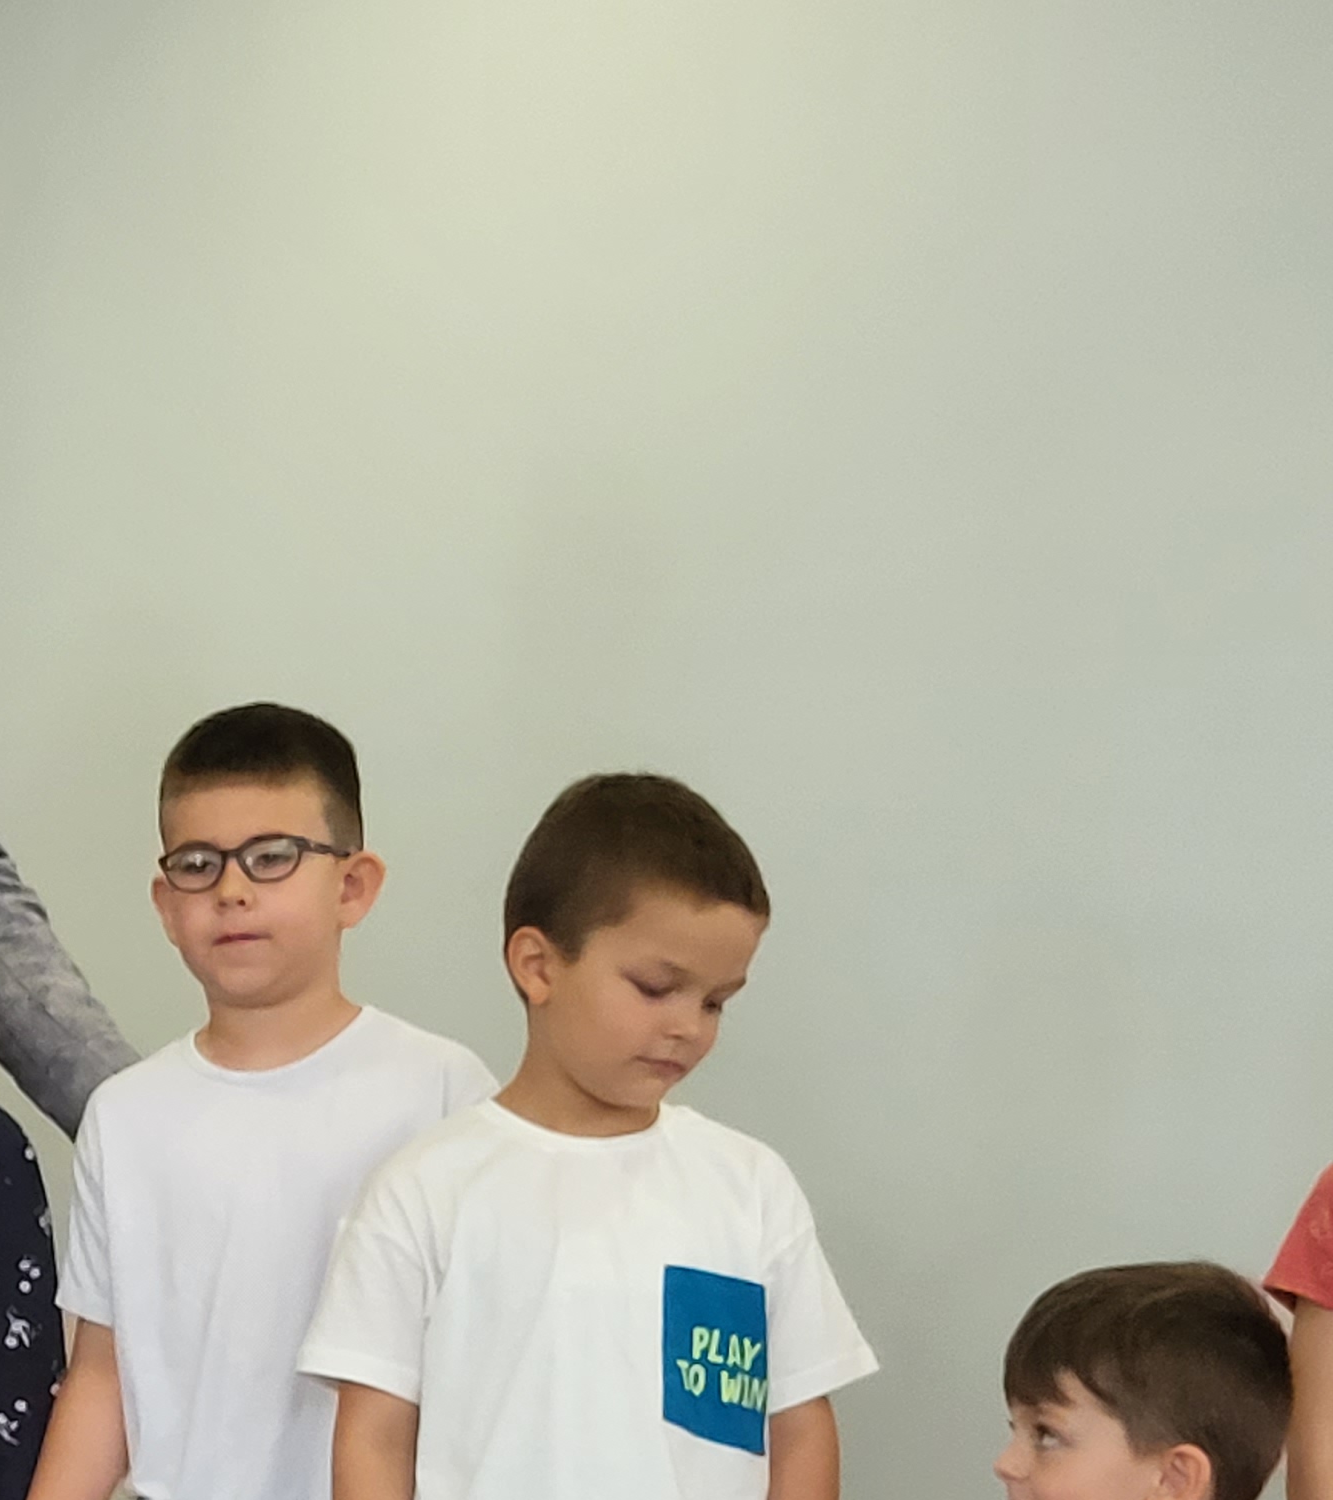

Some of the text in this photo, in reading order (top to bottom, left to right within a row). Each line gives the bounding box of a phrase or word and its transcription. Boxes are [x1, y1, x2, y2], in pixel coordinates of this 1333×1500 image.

[691, 1326, 762, 1371] PLAY
[675, 1359, 770, 1415] TO WIN
